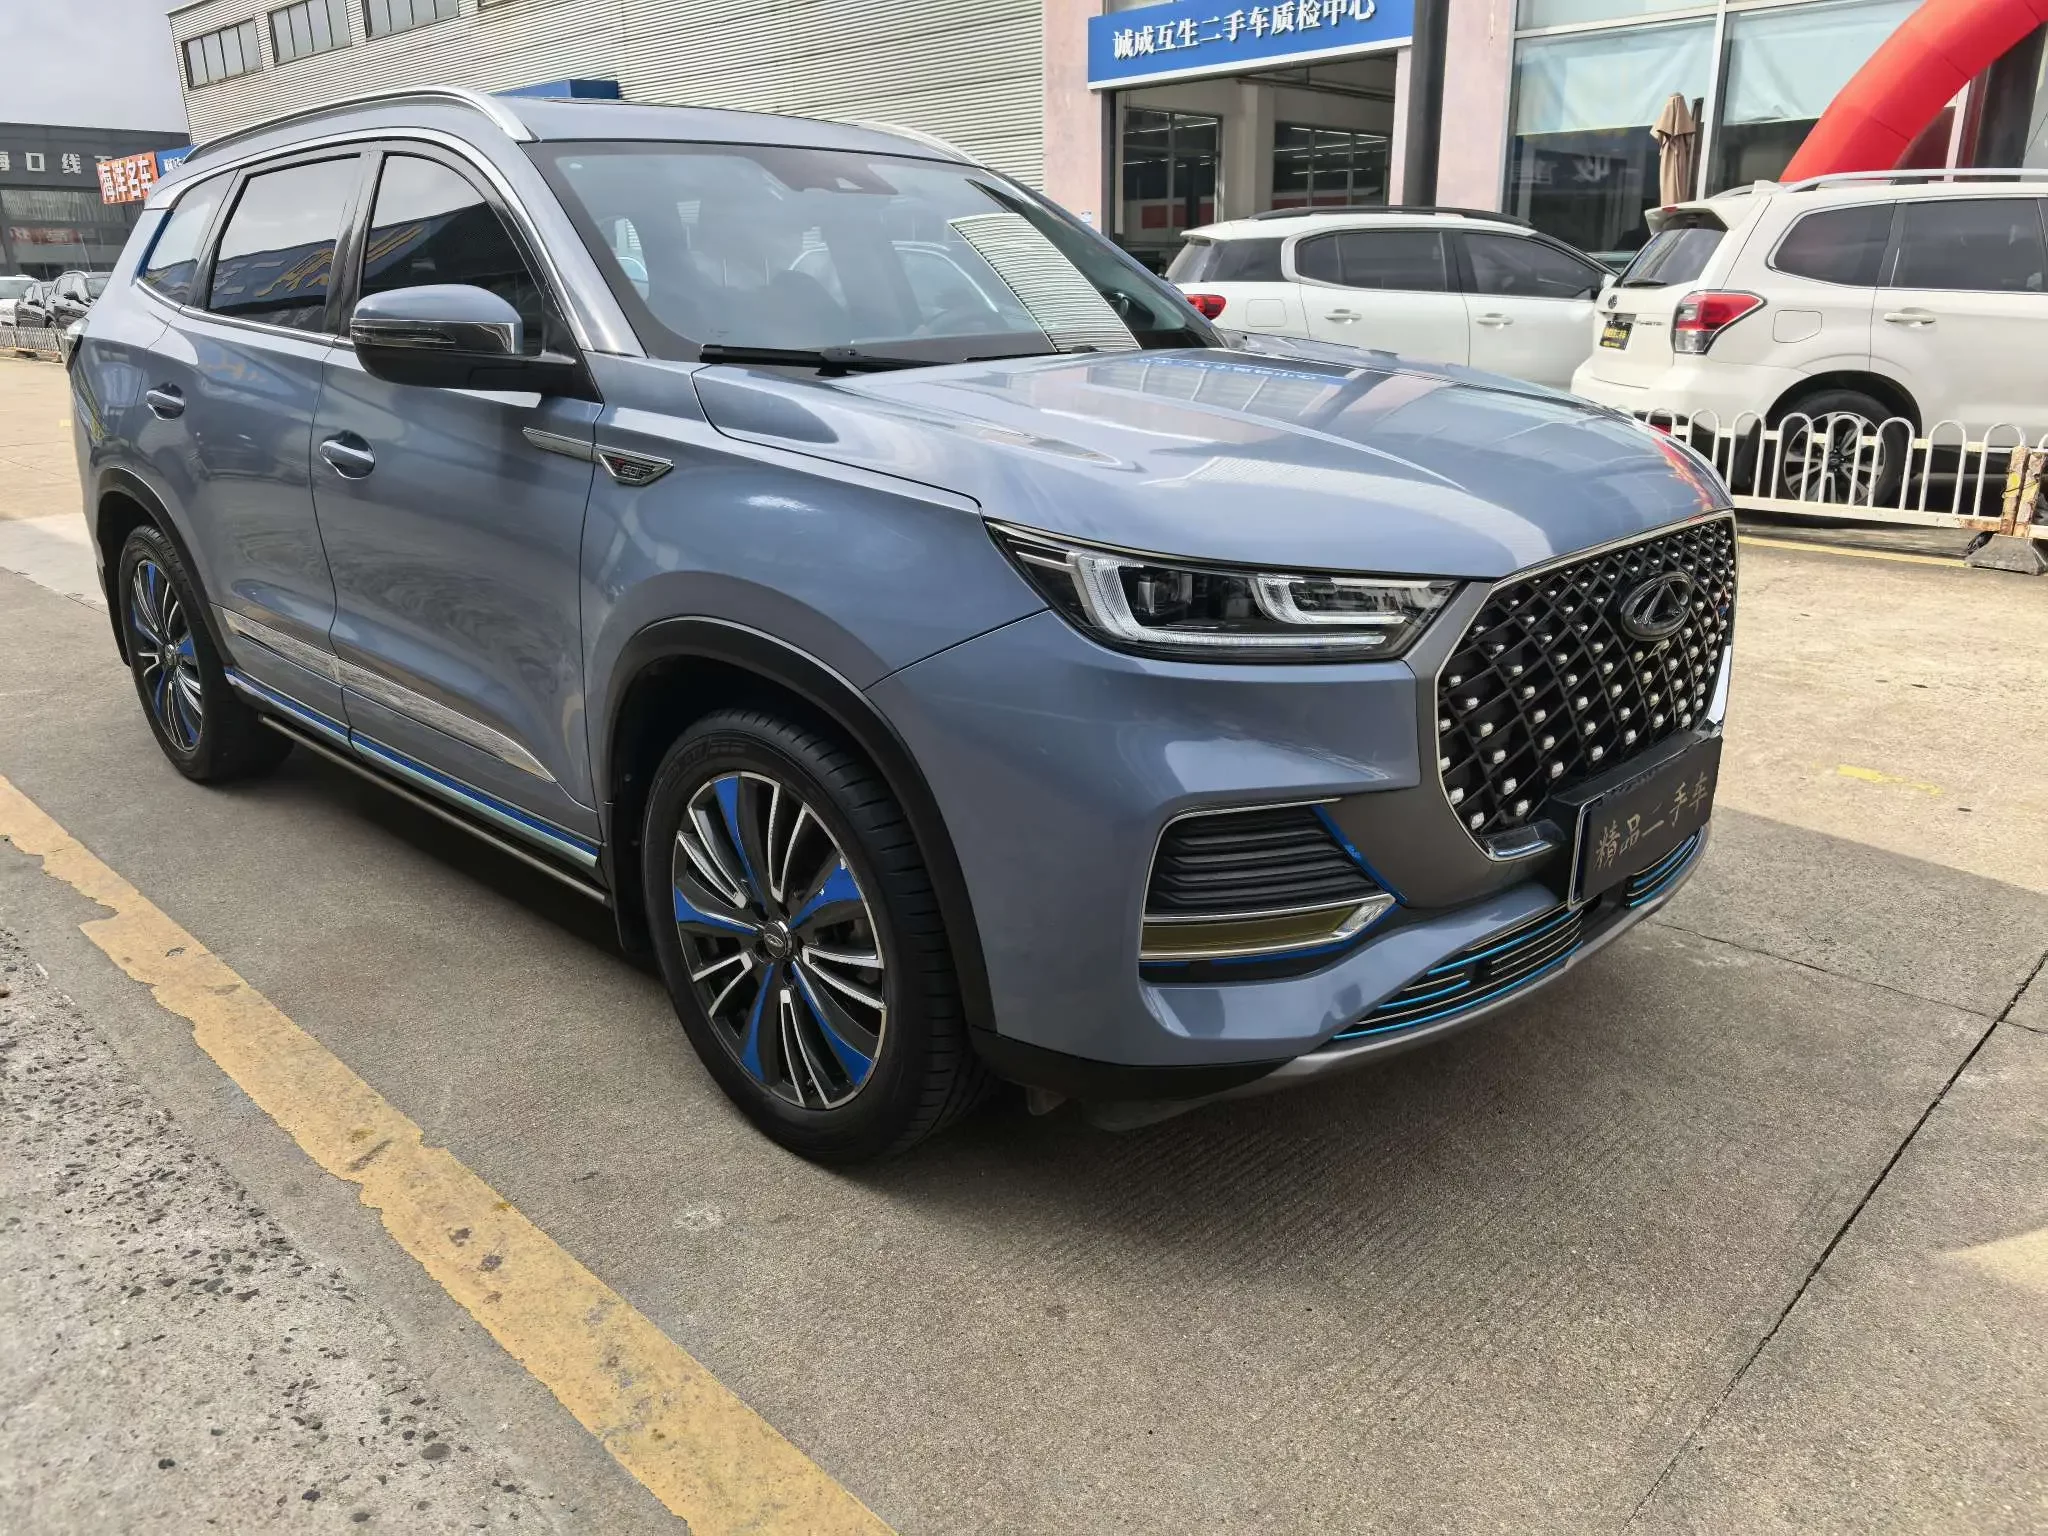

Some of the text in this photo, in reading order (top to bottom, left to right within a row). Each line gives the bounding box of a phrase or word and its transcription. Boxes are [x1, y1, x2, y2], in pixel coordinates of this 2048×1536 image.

[1114, 0, 1375, 60] 诚成互生二手车质检中心
[1594, 772, 1709, 870] 精品二手车
